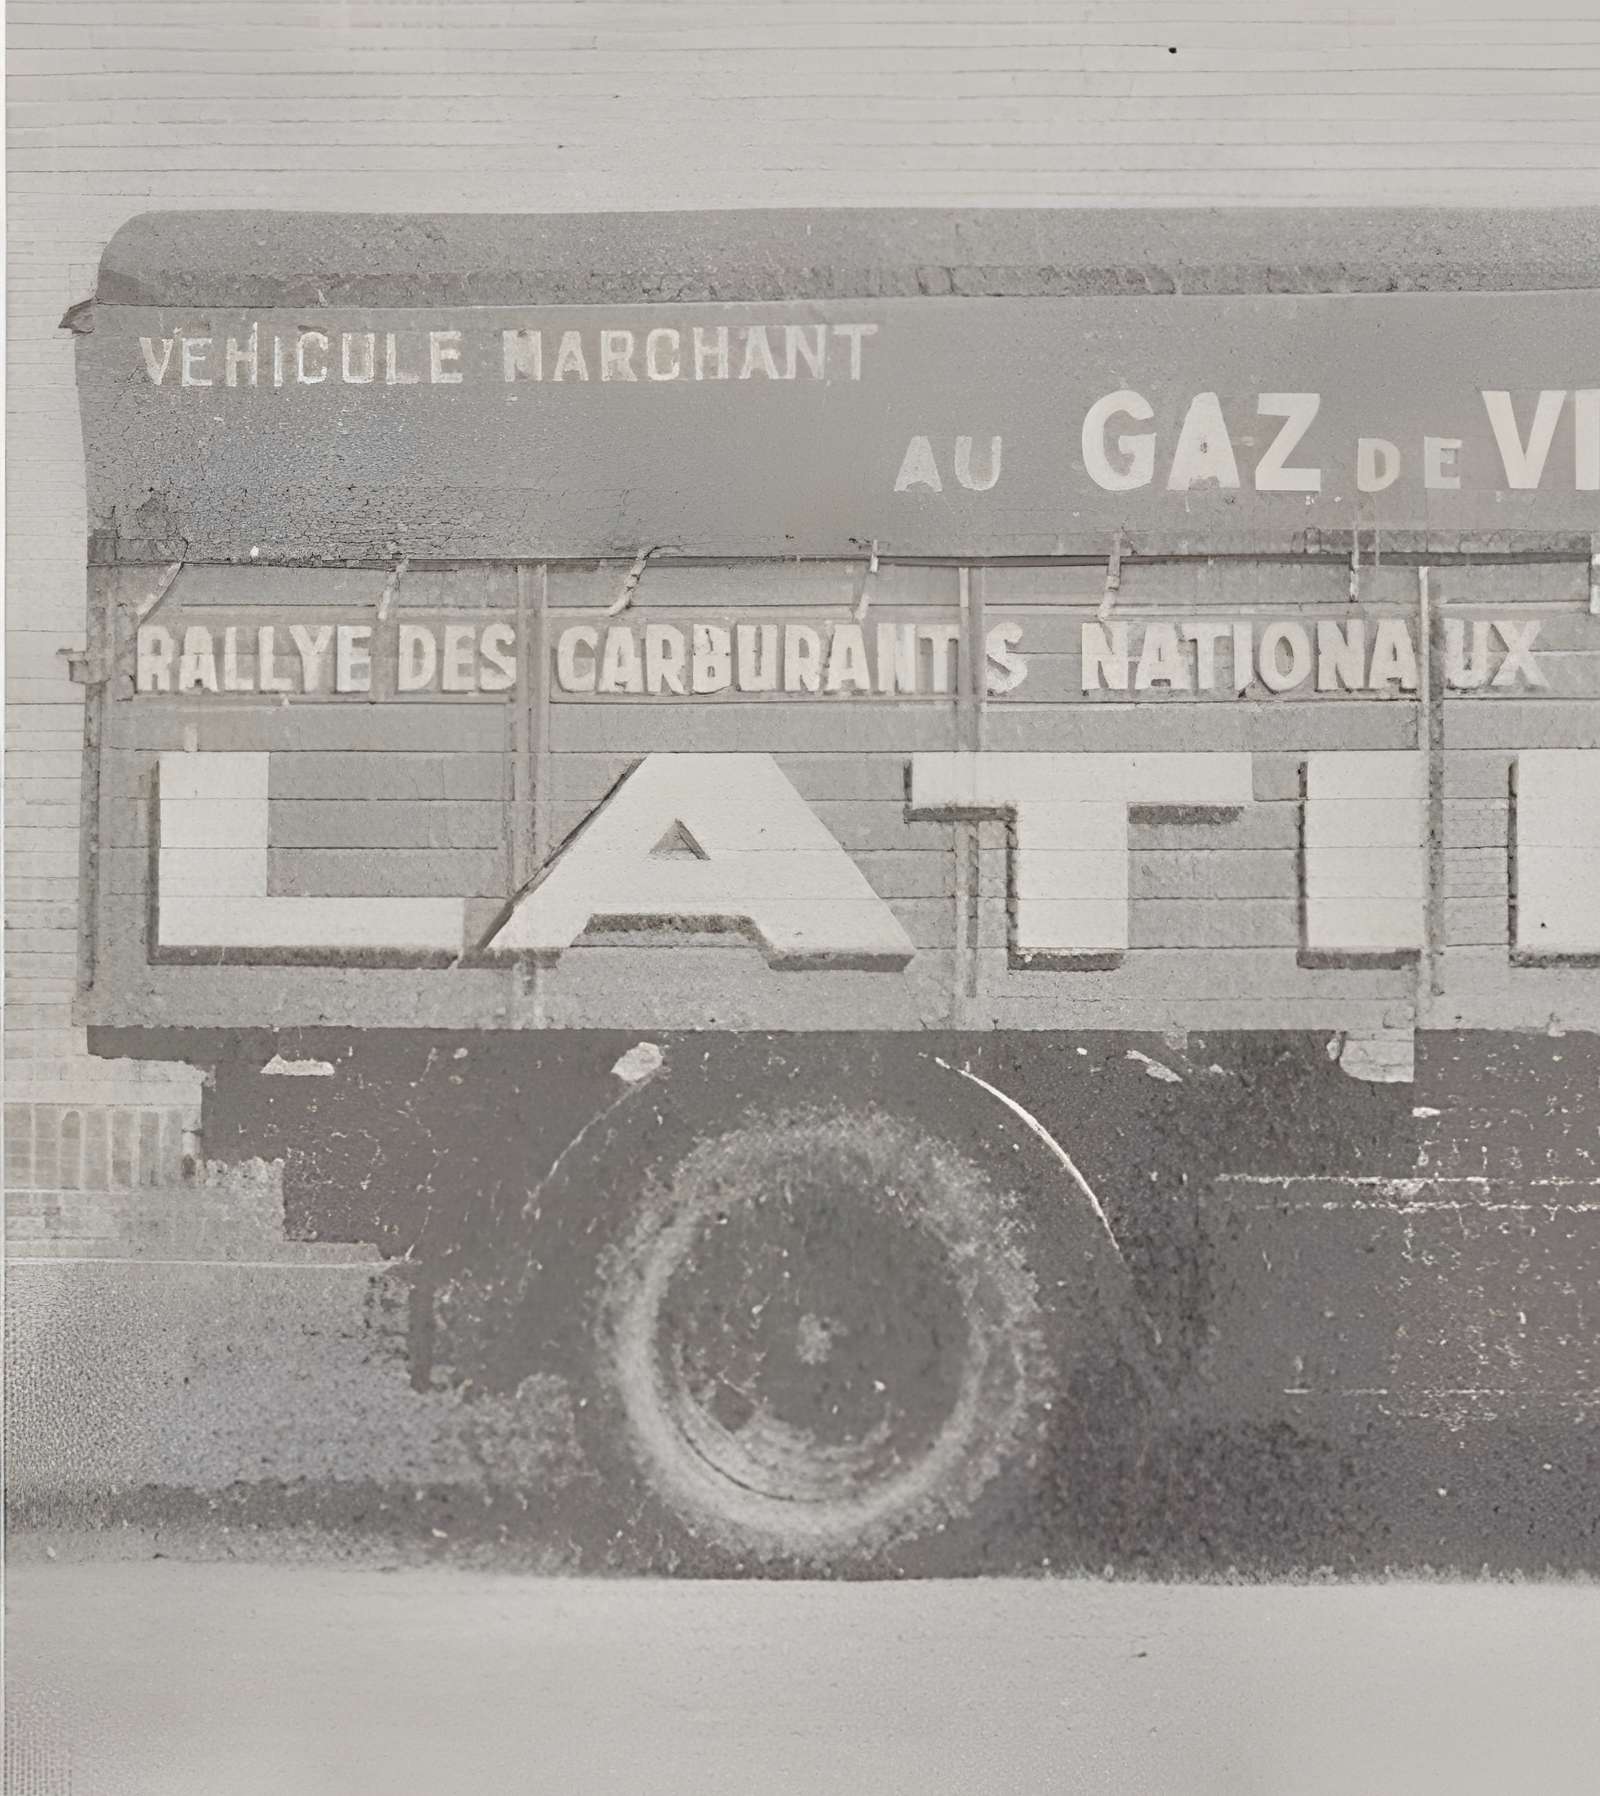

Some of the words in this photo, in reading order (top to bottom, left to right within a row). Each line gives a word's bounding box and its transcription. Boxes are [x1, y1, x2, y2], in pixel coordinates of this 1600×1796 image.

[502, 323, 878, 383] MARCHANT
[894, 435, 1002, 492] AU
[1082, 389, 1320, 491] GAZ
[1357, 436, 1462, 492] DE
[136, 624, 372, 692] RALLYE
[398, 623, 517, 692] DES
[557, 621, 1028, 695] CARBURANTS
[1080, 618, 1549, 693] NATIONAUX
